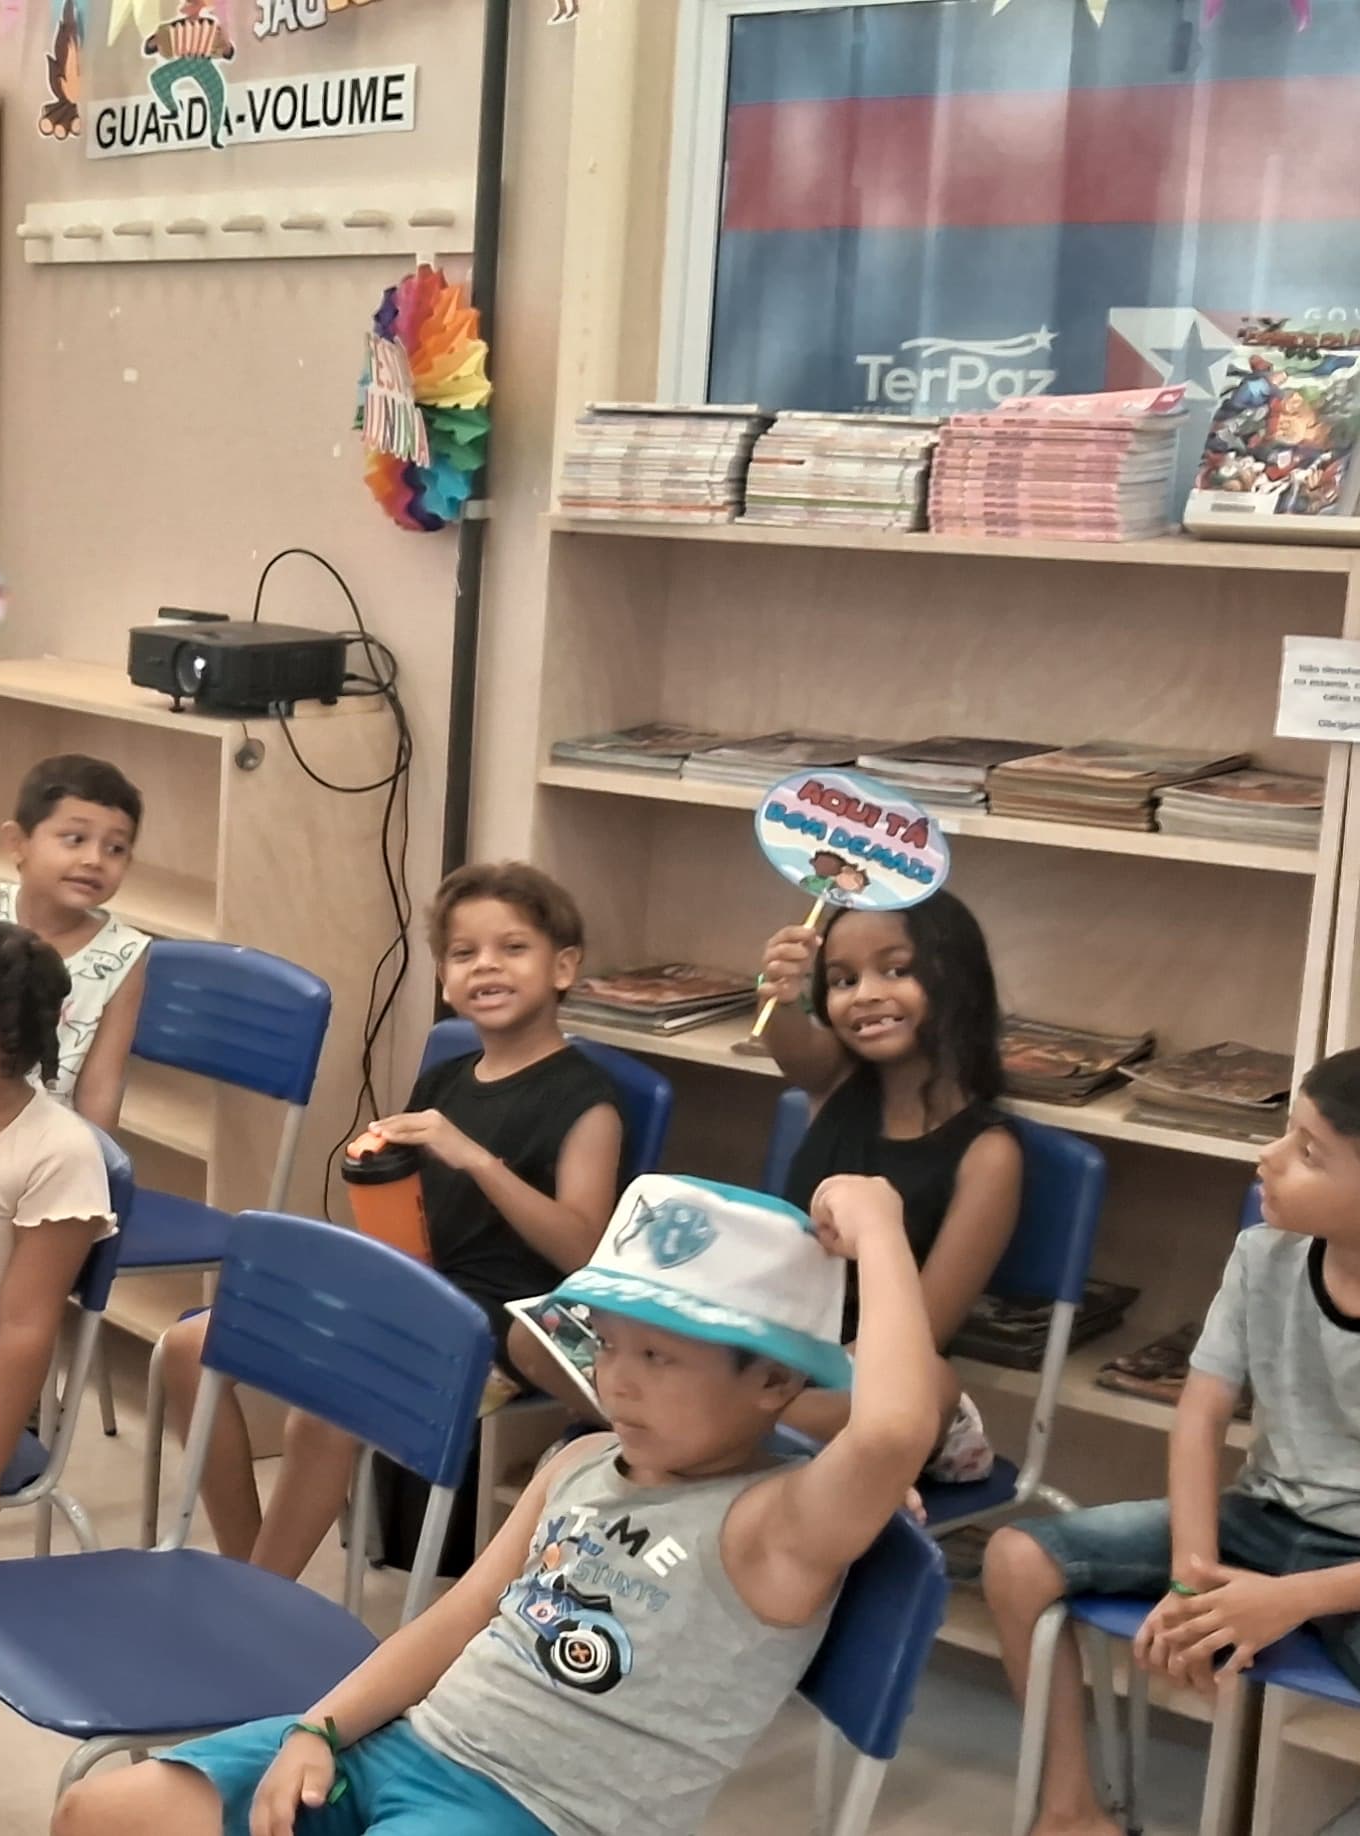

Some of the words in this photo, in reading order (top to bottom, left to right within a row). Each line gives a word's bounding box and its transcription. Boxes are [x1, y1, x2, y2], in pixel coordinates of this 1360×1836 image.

[96, 74, 406, 149] GUARD-VOLUME
[855, 354, 1058, 402] TerPaz
[764, 800, 828, 841] BOM
[828, 826, 936, 885] DEMAIS
[797, 779, 882, 829] AQUI
[885, 812, 930, 850] TÁ
